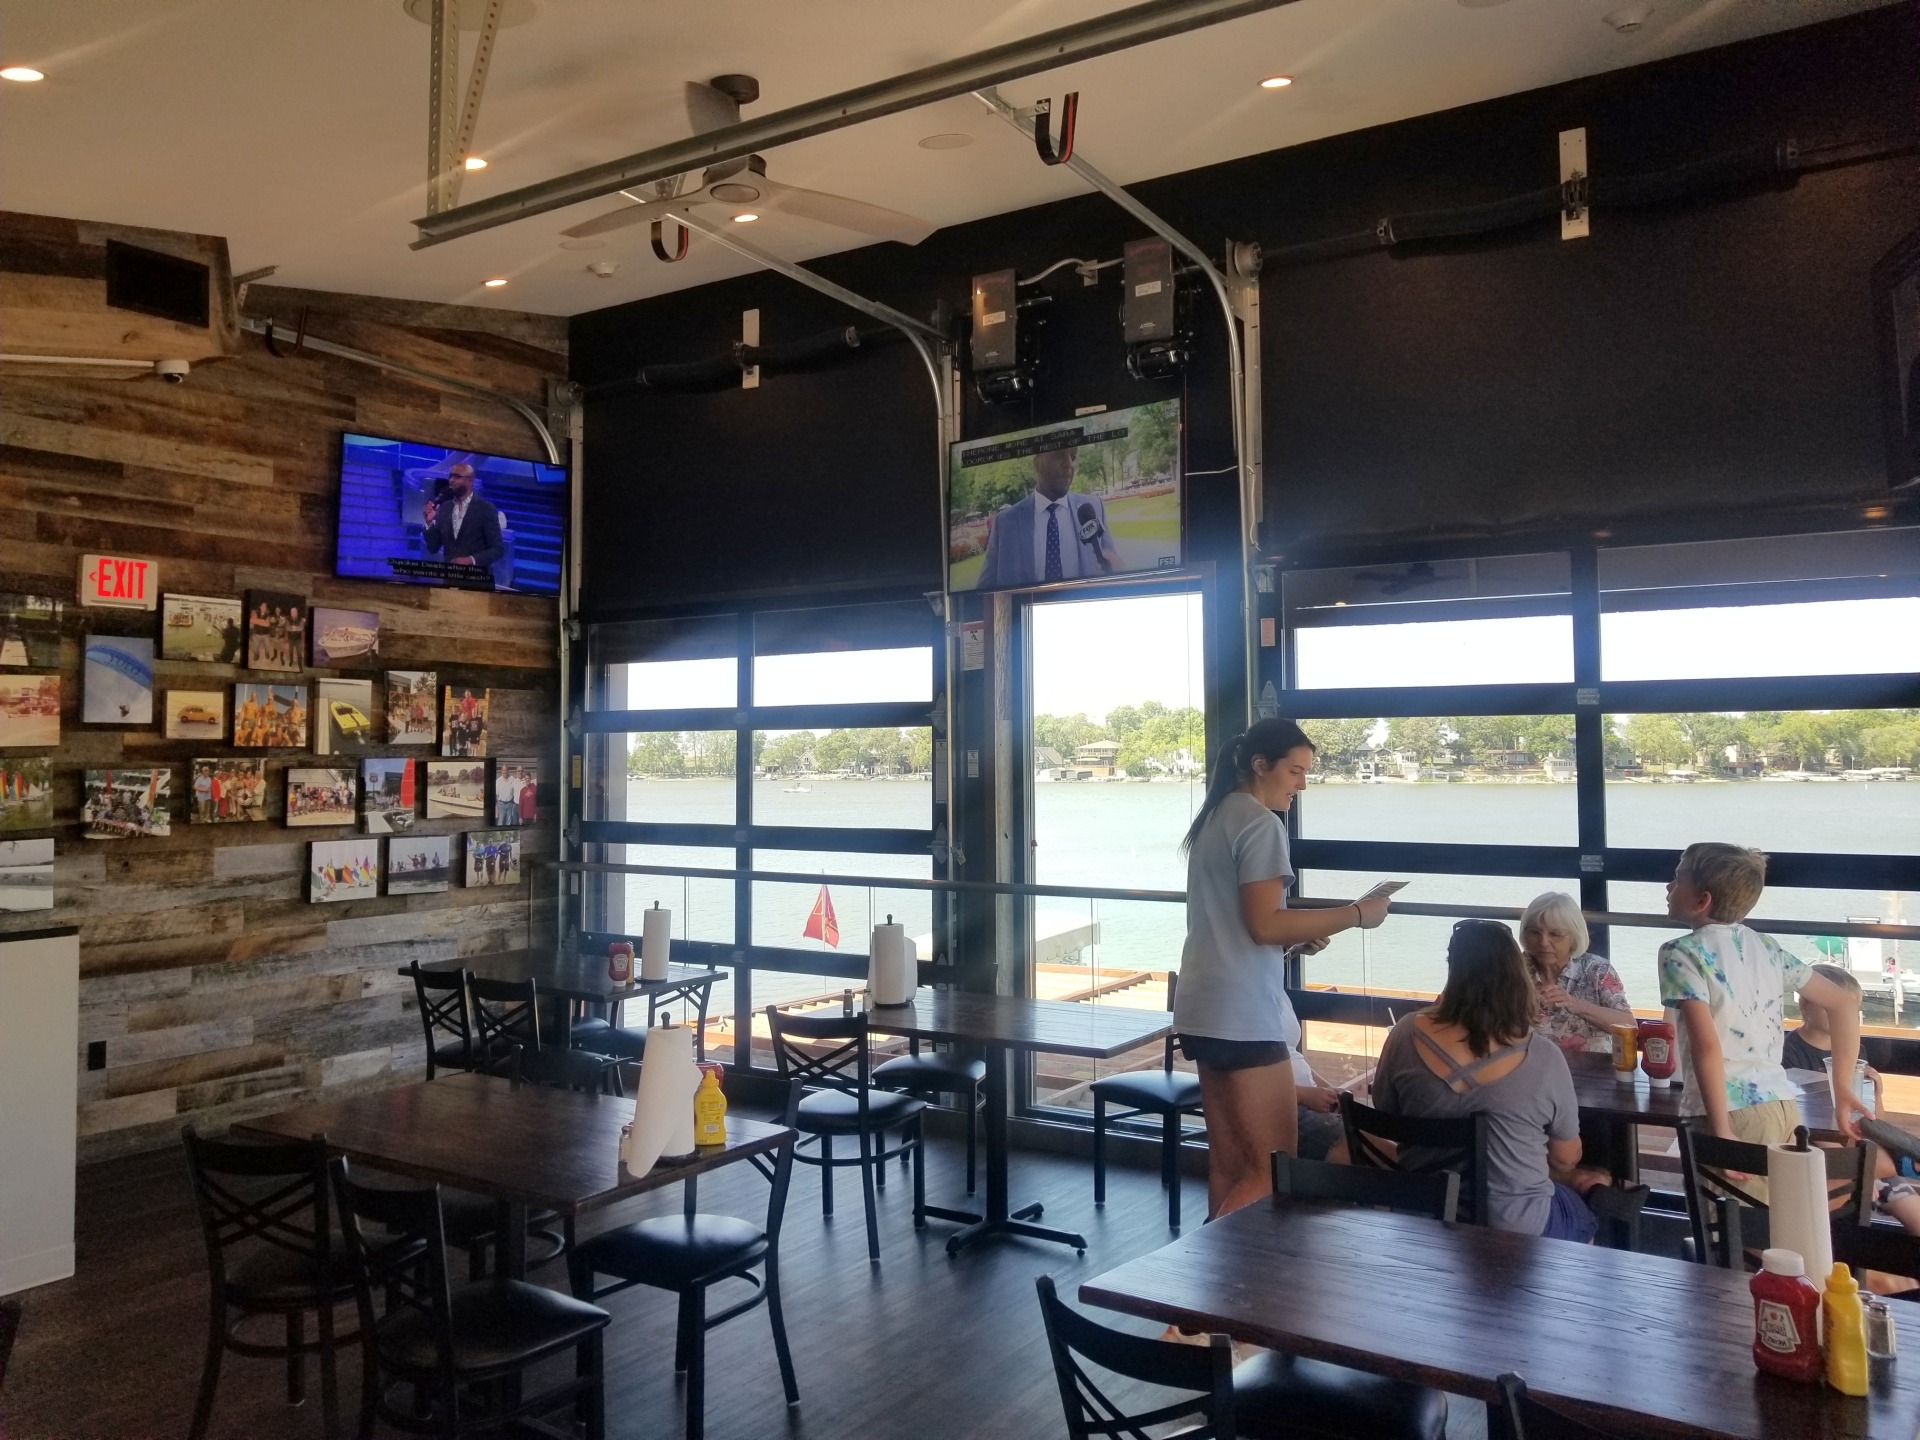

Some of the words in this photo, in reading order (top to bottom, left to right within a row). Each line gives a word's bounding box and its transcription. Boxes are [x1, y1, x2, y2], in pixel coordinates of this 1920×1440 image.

[1005, 440, 1027, 449] MORE
[1050, 430, 1075, 440] SARA
[1017, 447, 1034, 457] THE
[1039, 442, 1062, 451] REST
[1087, 434, 1104, 442] THE
[1083, 521, 1095, 534] FOX
[1160, 557, 1174, 566] FS2
[98, 558, 147, 599] EXIT
